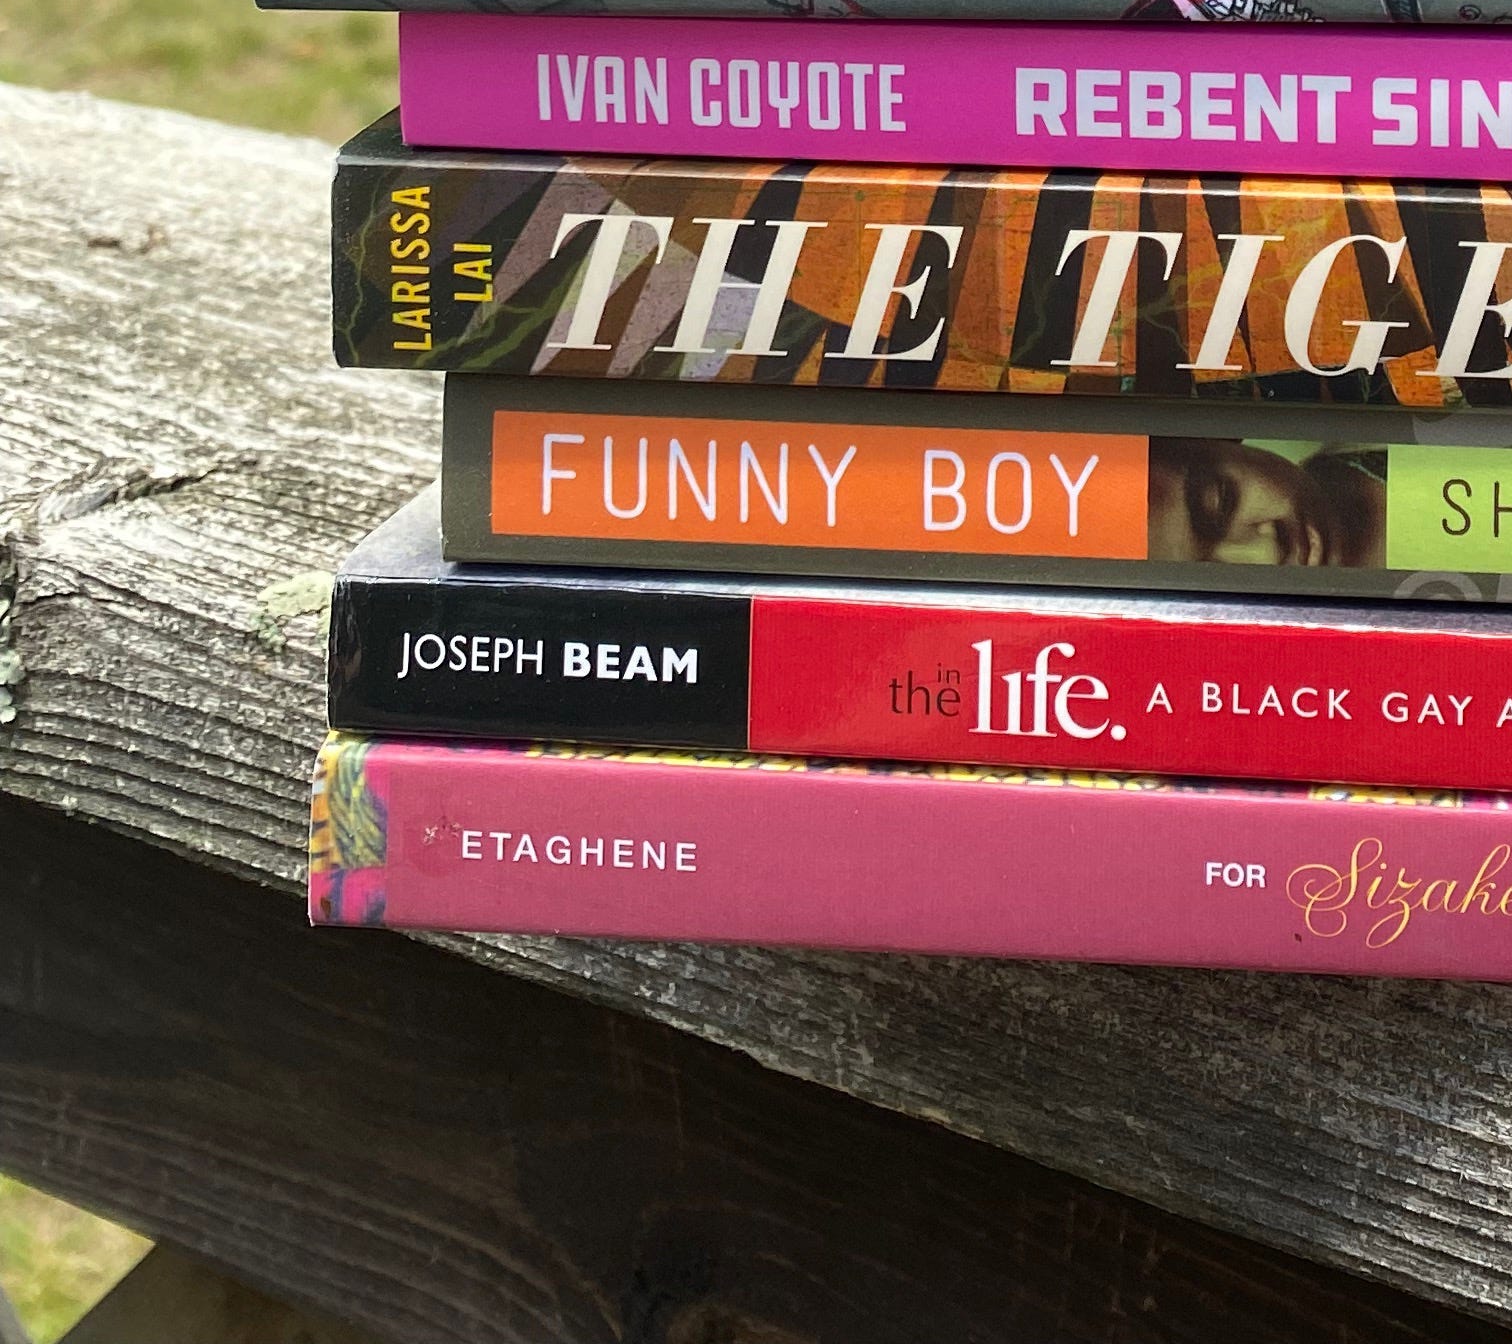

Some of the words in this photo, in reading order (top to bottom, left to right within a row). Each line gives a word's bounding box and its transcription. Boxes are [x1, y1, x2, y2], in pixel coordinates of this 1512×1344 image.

[538, 53, 669, 127] IVAN
[689, 58, 907, 133] COYOTE
[1014, 66, 1352, 144] REBENT
[390, 186, 433, 351] LARISSA
[453, 243, 494, 302] LAI
[545, 212, 967, 362] THE
[541, 432, 858, 527] FUNNY
[923, 449, 1099, 538] BOY
[397, 632, 544, 679] JOSEPH
[562, 642, 699, 684] BEAM
[937, 662, 961, 685] in
[889, 670, 961, 717] the
[1146, 682, 1174, 714] A
[1201, 682, 1354, 721] BLACK
[1381, 693, 1475, 727] GAY
[461, 830, 698, 872] ETAGHENE
[1205, 861, 1266, 888] FOR
